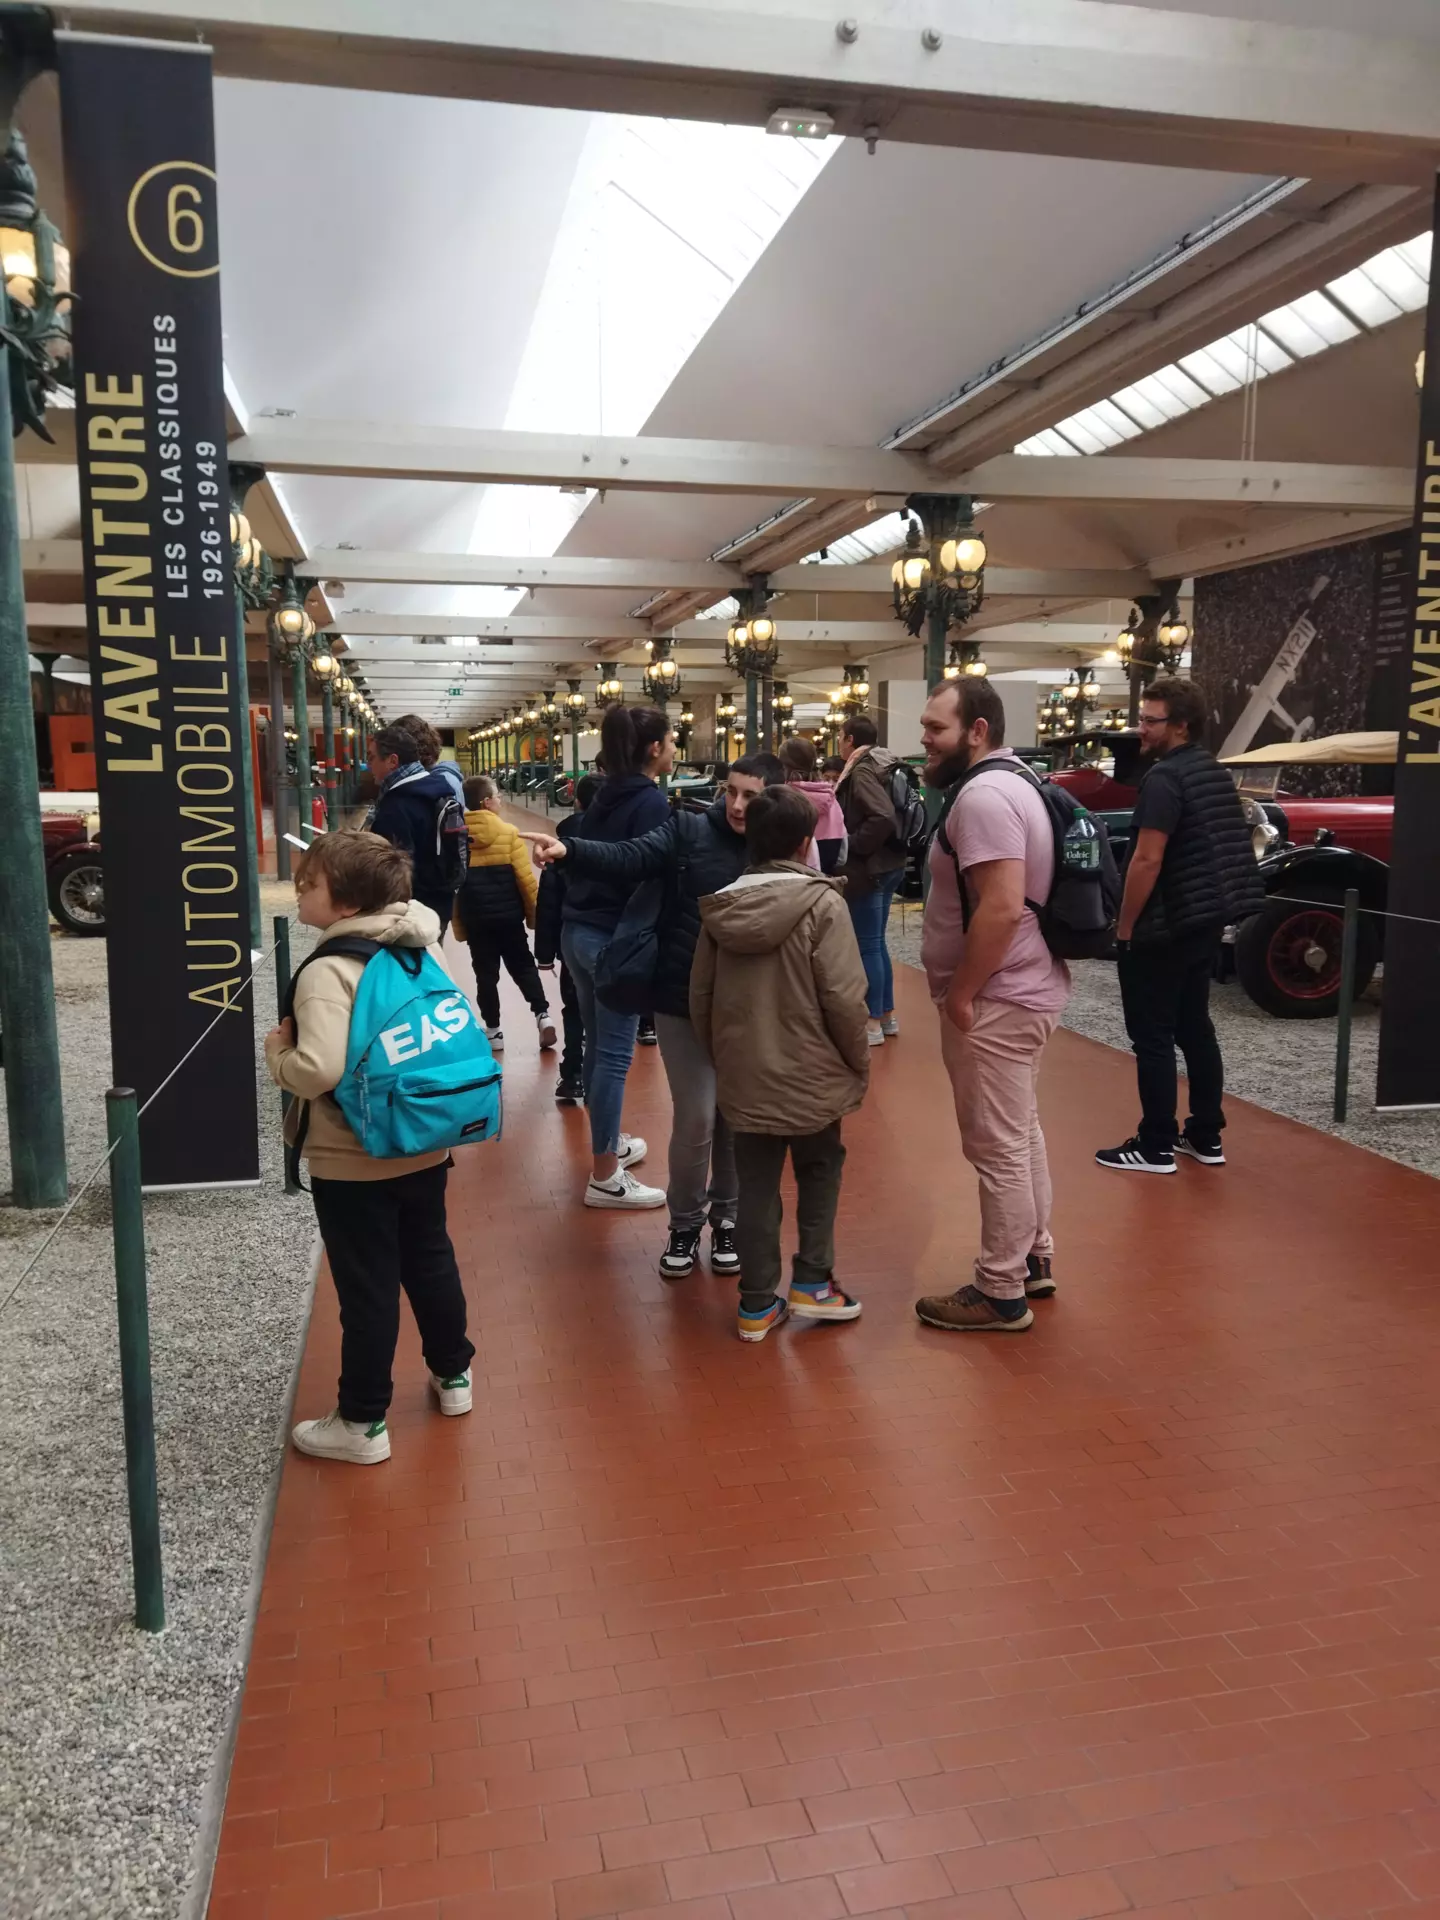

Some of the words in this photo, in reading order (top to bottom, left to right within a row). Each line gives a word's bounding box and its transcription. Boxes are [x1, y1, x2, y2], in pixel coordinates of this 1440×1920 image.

[168, 184, 204, 253] 6
[153, 314, 186, 526] CLASSIQUES
[84, 372, 164, 772] L'AVENTURE
[164, 542, 189, 599] LES
[195, 441, 225, 599] 1926-1949
[169, 634, 243, 1013] AUTOMOBILE
